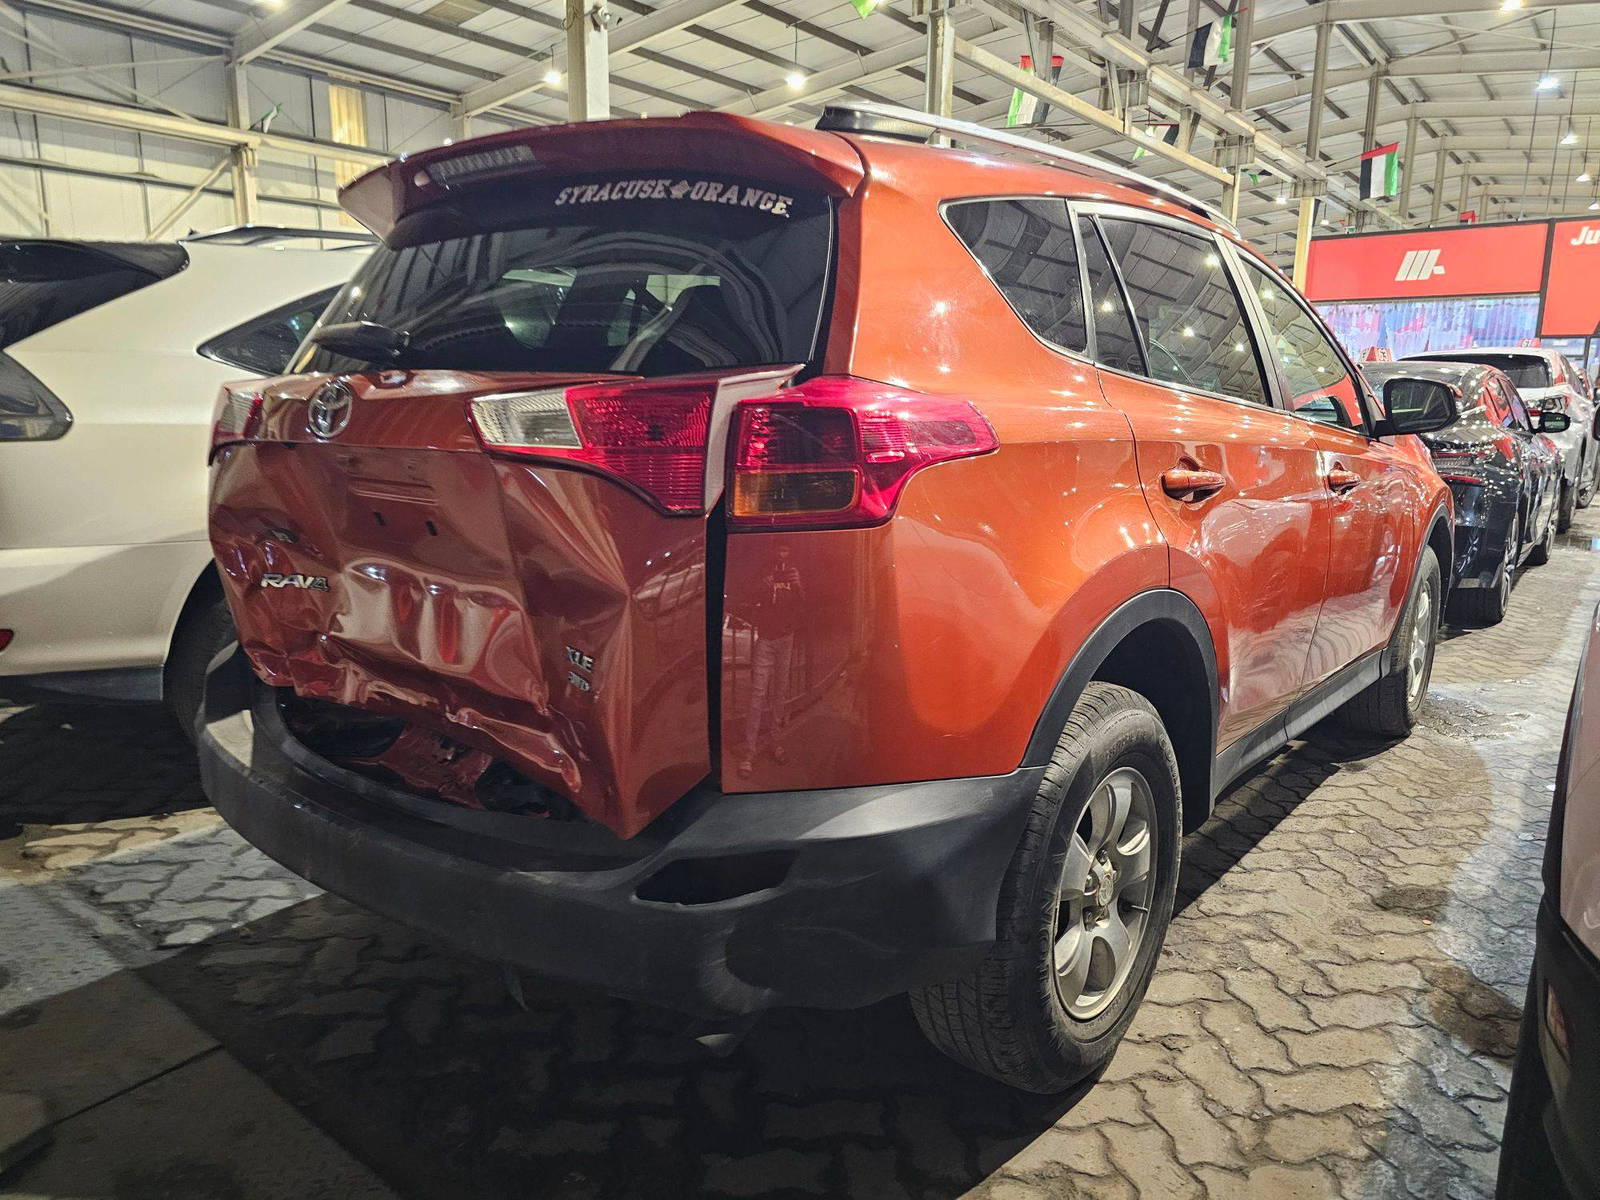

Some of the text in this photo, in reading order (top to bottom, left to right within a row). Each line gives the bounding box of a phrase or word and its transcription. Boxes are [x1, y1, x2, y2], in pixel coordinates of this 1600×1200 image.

[554, 179, 793, 218] SYRACUSE ORANGE
[260, 573, 329, 593] RAV4
